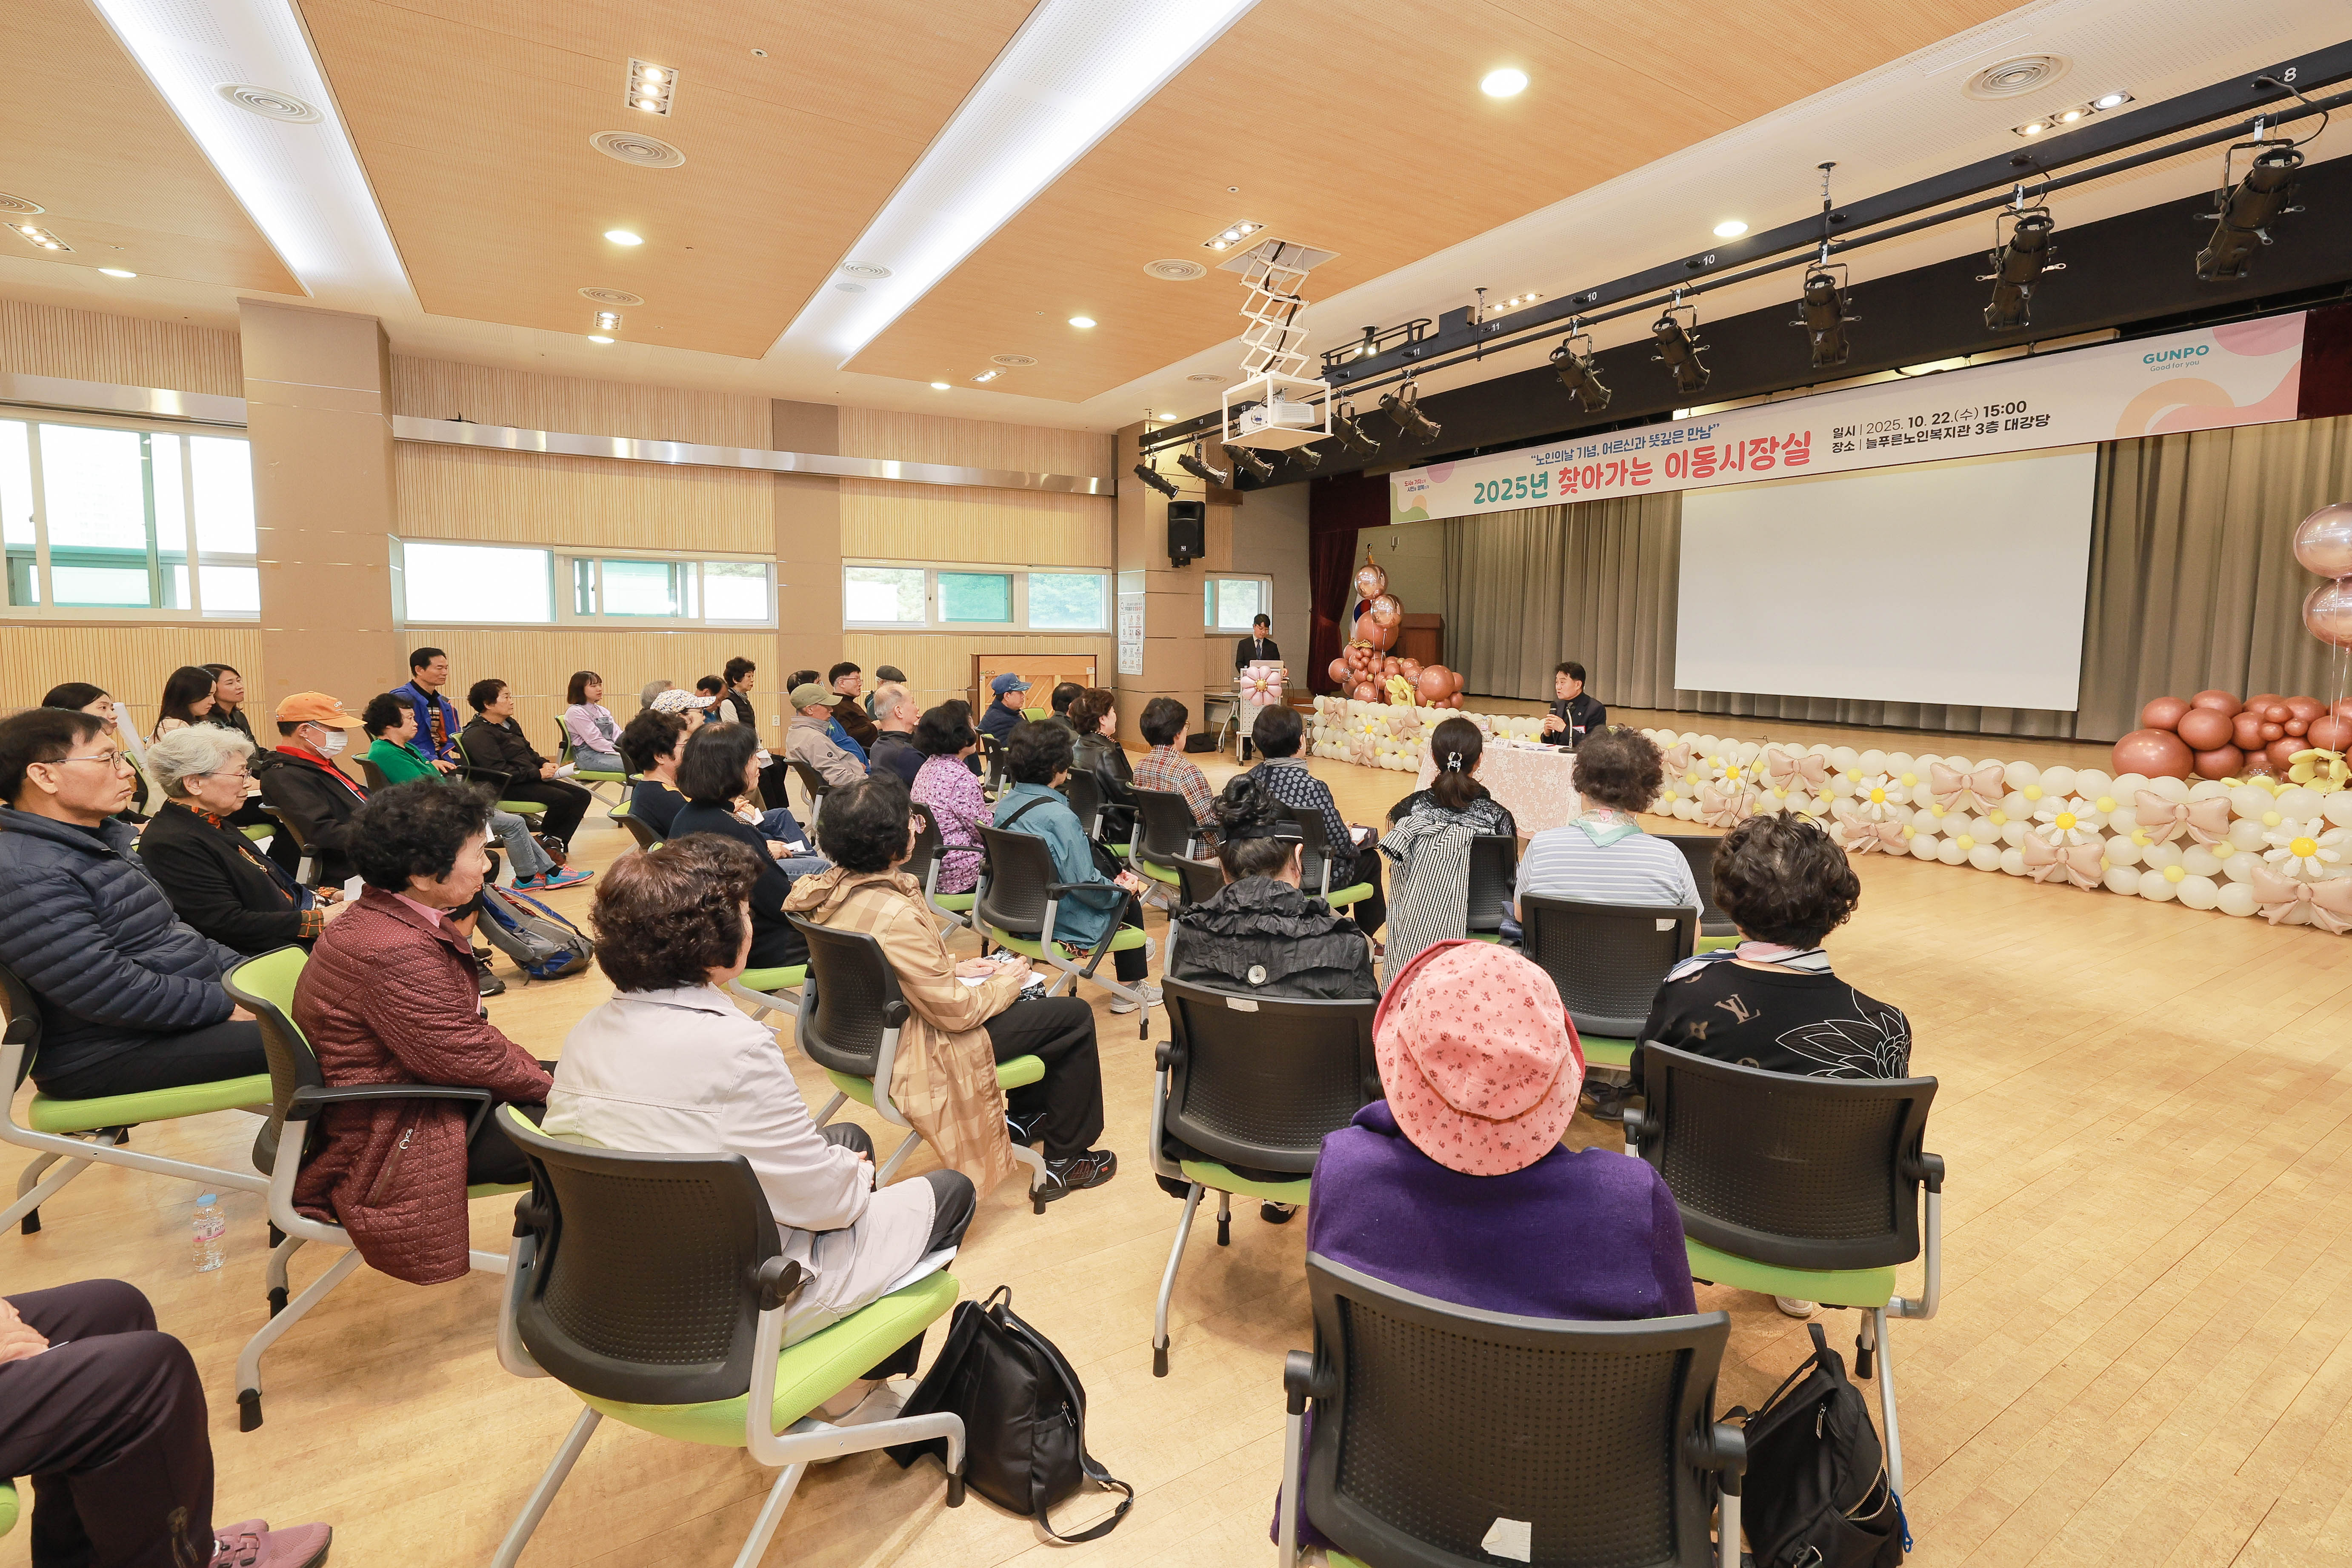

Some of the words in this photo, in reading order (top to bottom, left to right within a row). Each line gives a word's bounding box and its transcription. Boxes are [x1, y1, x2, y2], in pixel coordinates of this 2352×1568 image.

[2284, 68, 2296, 82] 8
[1703, 254, 1715, 266] 10
[1587, 291, 1597, 302] 10
[1491, 322, 1500, 332] 11
[1413, 347, 1420, 356] 11
[2143, 345, 2209, 364] GUNPO
[2150, 363, 2170, 371] Good
[1833, 426, 1855, 439] 일시
[1866, 419, 1903, 434] 2025.
[1909, 416, 1927, 428] 10.
[1983, 401, 2027, 418] 15:00
[1832, 441, 1855, 453] 장소
[1866, 426, 1971, 449] 늘푸른노인복지관
[1975, 421, 1999, 434] 3층
[2004, 413, 2051, 431] 대강당
[1576, 445, 1600, 459] 기념,
[1603, 439, 1646, 456] 어르신과
[1649, 429, 1684, 448] 뜻깊은
[1474, 471, 1548, 505] 2025년
[1558, 457, 1653, 496] 찾아가는
[1665, 430, 1811, 480] 이동시장실
